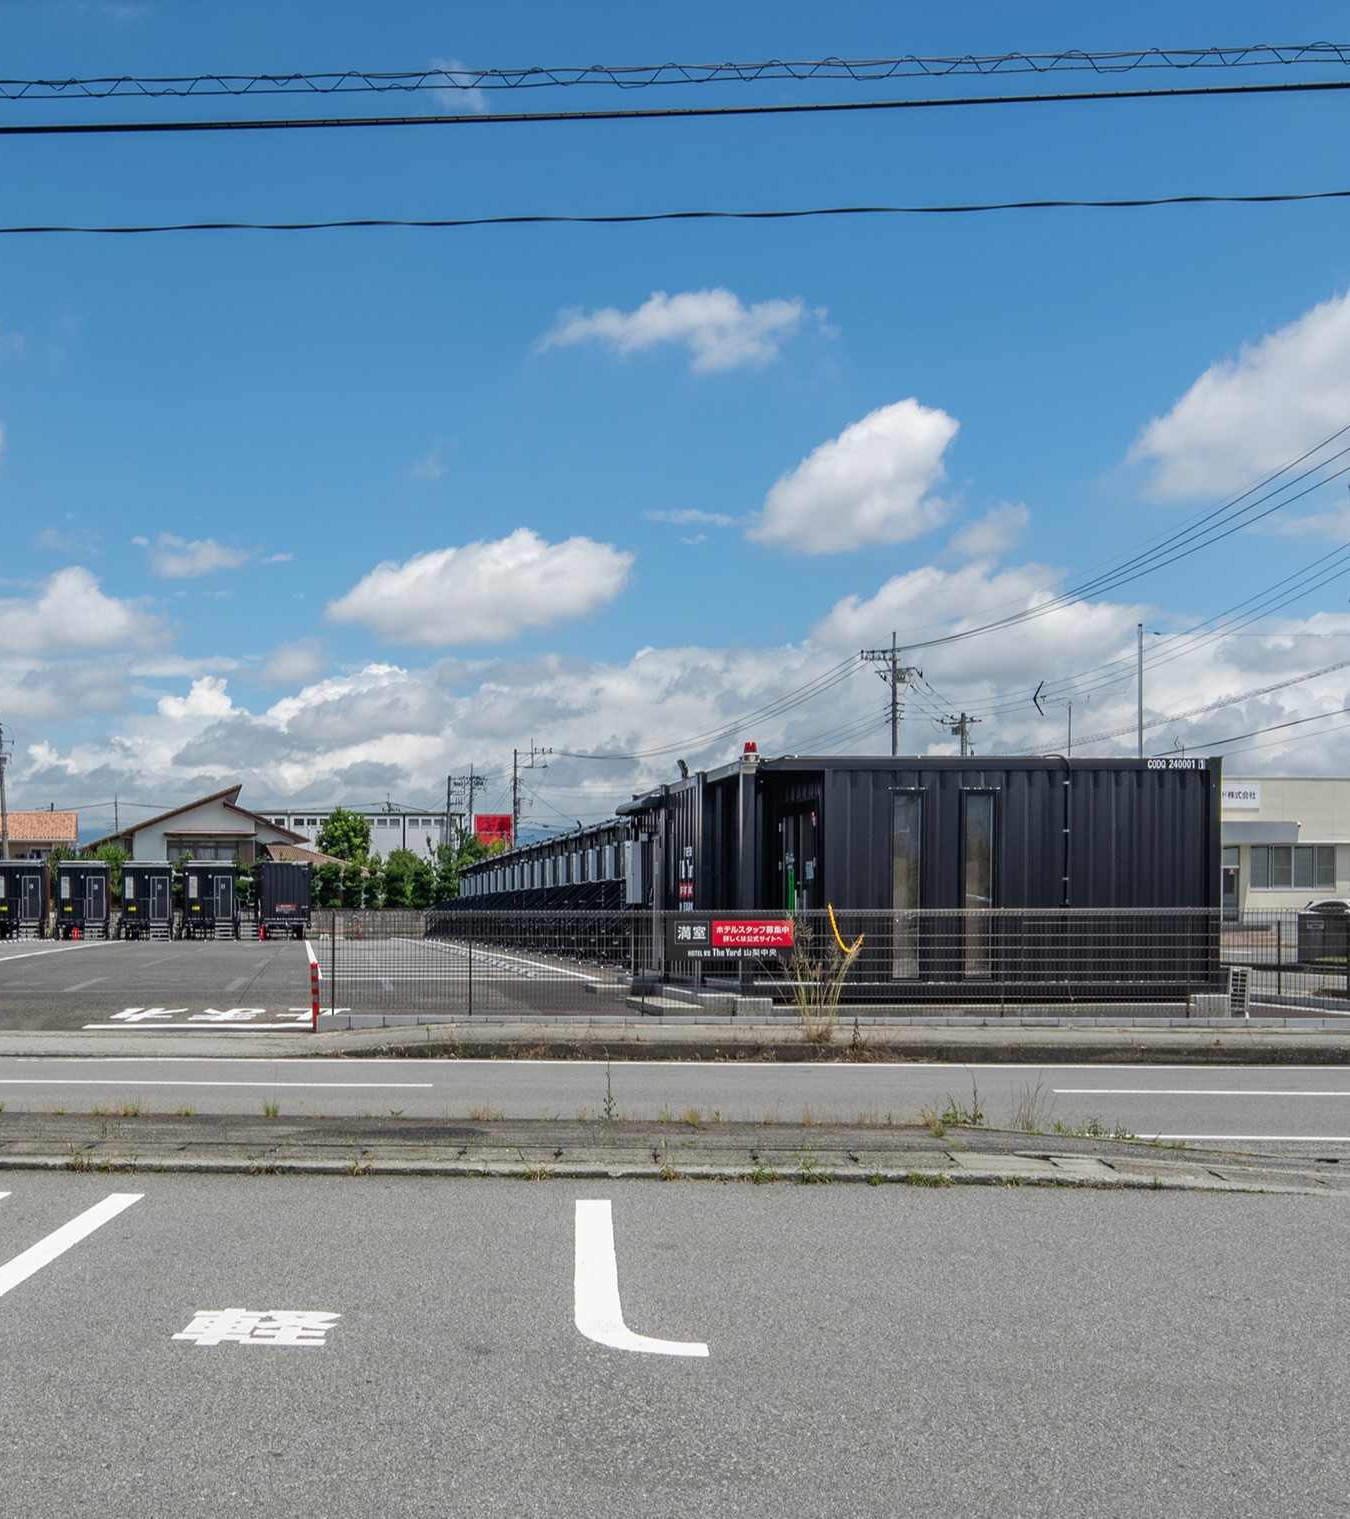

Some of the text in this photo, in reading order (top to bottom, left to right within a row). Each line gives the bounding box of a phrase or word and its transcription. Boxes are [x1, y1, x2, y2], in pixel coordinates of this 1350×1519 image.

[1168, 759, 1196, 769] 240001
[677, 926, 707, 940] 満室
[716, 925, 790, 934] ホテルスタッフ募集中
[723, 935, 783, 943] 詳しくは公式サイトへ
[712, 948, 725, 957] The
[725, 948, 742, 957] Yard
[743, 948, 777, 957] 山梨中央
[170, 1308, 342, 1346] 軽
